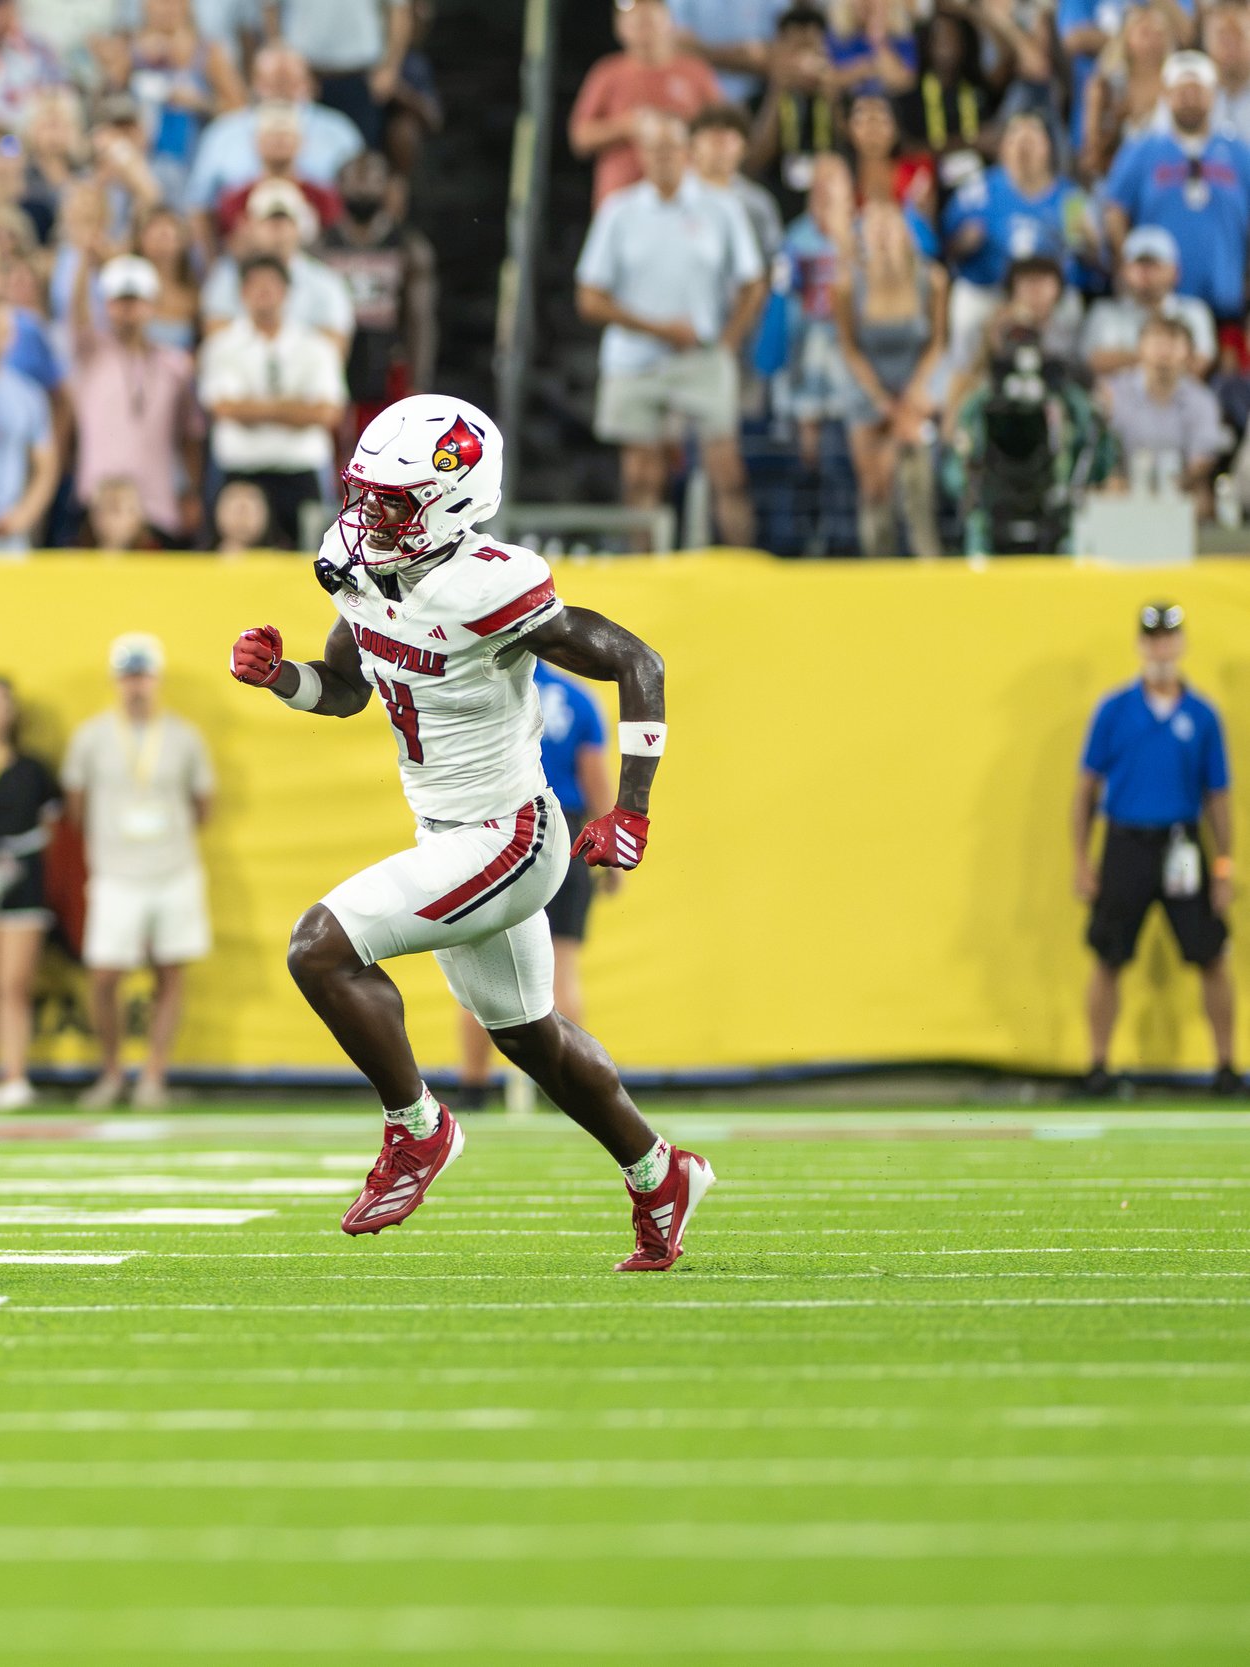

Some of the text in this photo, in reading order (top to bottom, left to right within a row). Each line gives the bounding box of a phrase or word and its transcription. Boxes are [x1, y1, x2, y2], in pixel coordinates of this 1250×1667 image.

[469, 546, 511, 562] 4
[353, 622, 448, 677] LOUISVILLE
[373, 667, 424, 765] 4
